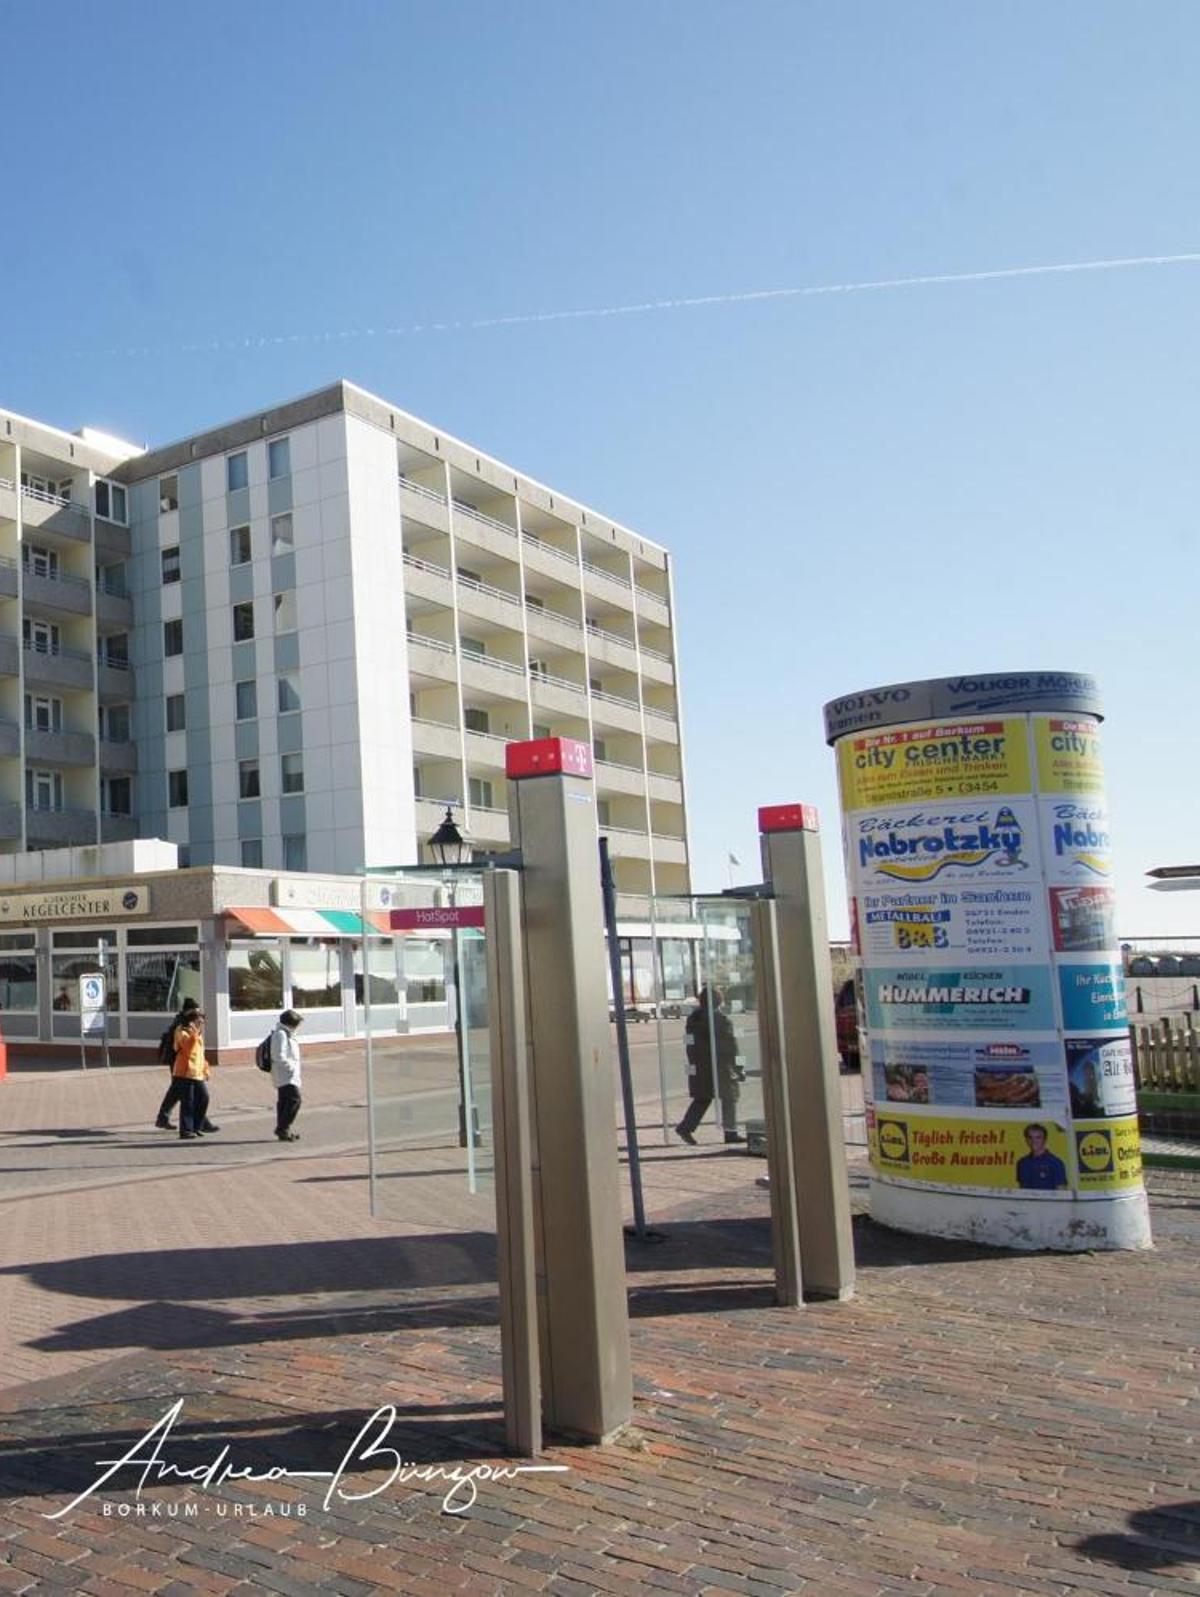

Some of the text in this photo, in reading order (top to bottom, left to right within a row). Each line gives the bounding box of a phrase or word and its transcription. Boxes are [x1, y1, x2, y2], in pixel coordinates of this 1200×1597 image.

[947, 677, 1030, 694] VOLKER
[833, 688, 911, 715] VOLVO
[855, 734, 1006, 769] city center
[1051, 731, 1087, 756] city
[858, 811, 990, 833] Bäckerei
[859, 825, 1022, 866] Nabrotzky
[23, 899, 111, 918] KEGELCENTER
[415, 909, 460, 924] HotSpot
[878, 984, 1024, 1004] HUMMERICH
[912, 1129, 954, 1147] Täglich
[911, 1151, 946, 1167] Große
[950, 1151, 1015, 1167] Auswahl!
